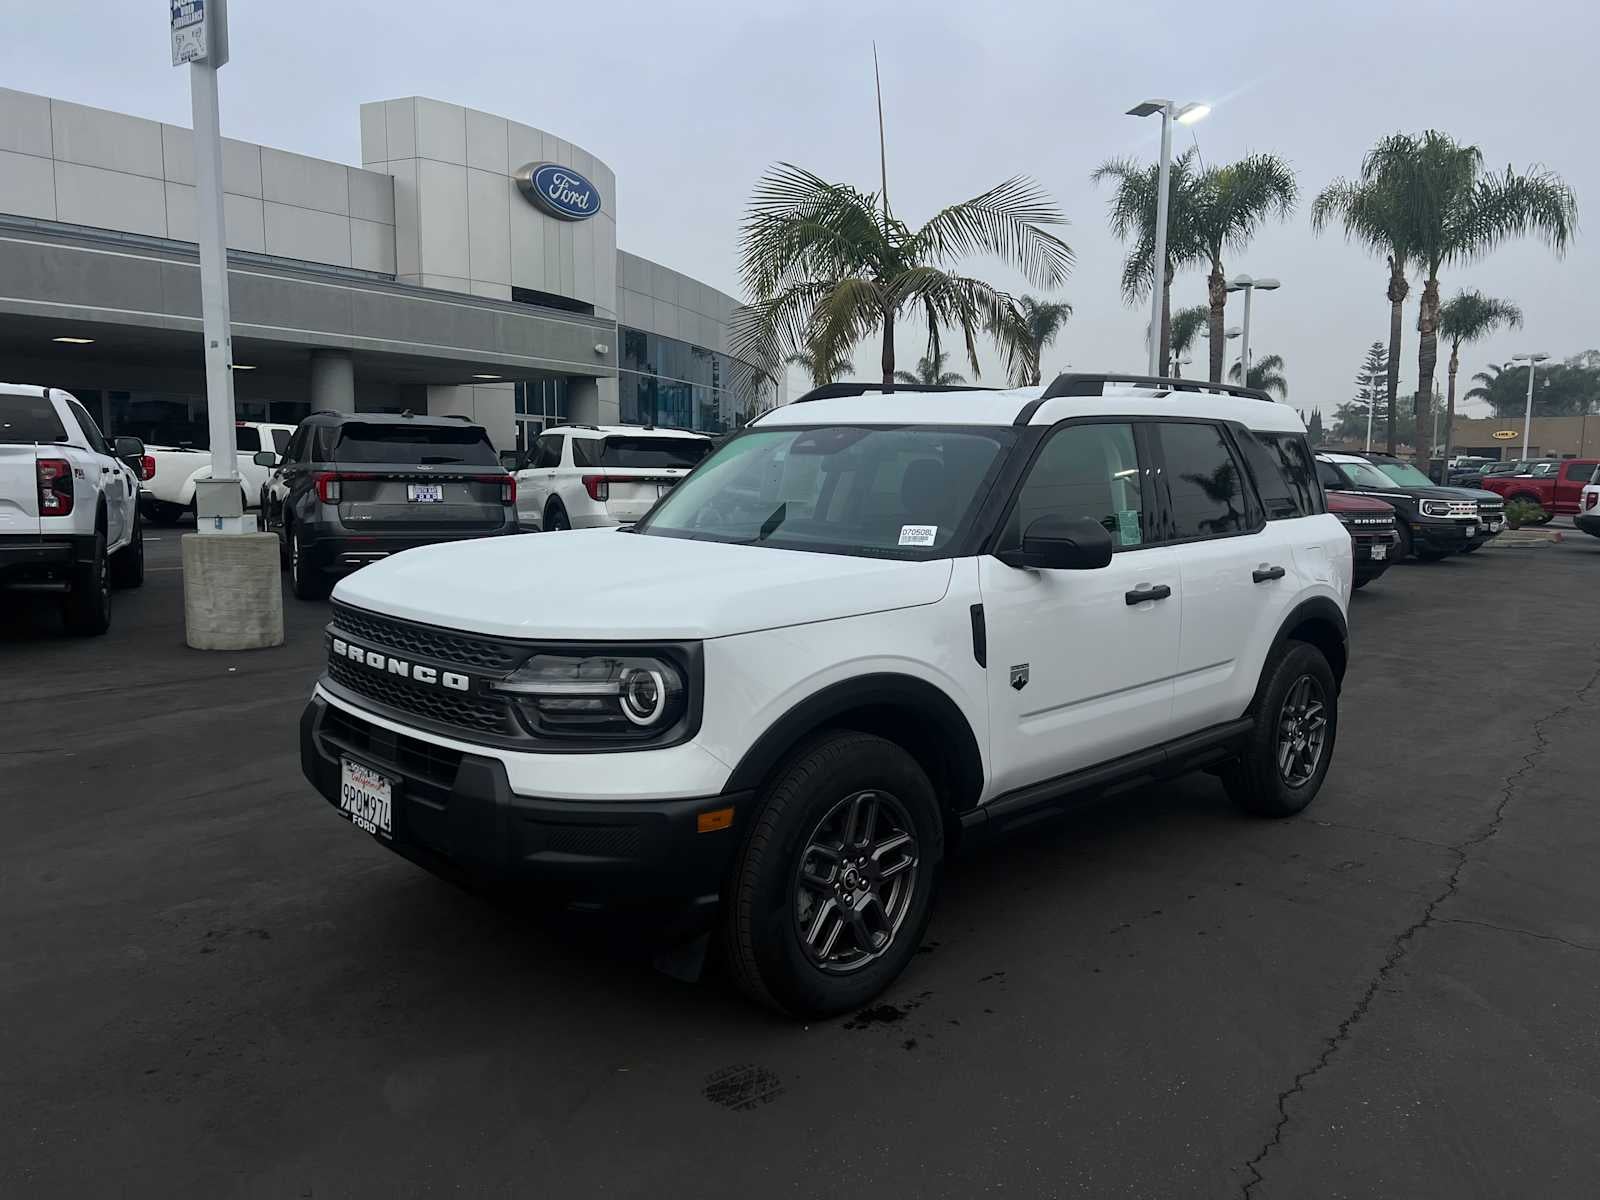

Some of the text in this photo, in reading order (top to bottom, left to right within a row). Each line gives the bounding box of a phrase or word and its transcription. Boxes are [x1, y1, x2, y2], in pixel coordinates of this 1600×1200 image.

[549, 173, 589, 209] Ford
[333, 638, 469, 691] BRONCO
[352, 814, 377, 834] FORD
